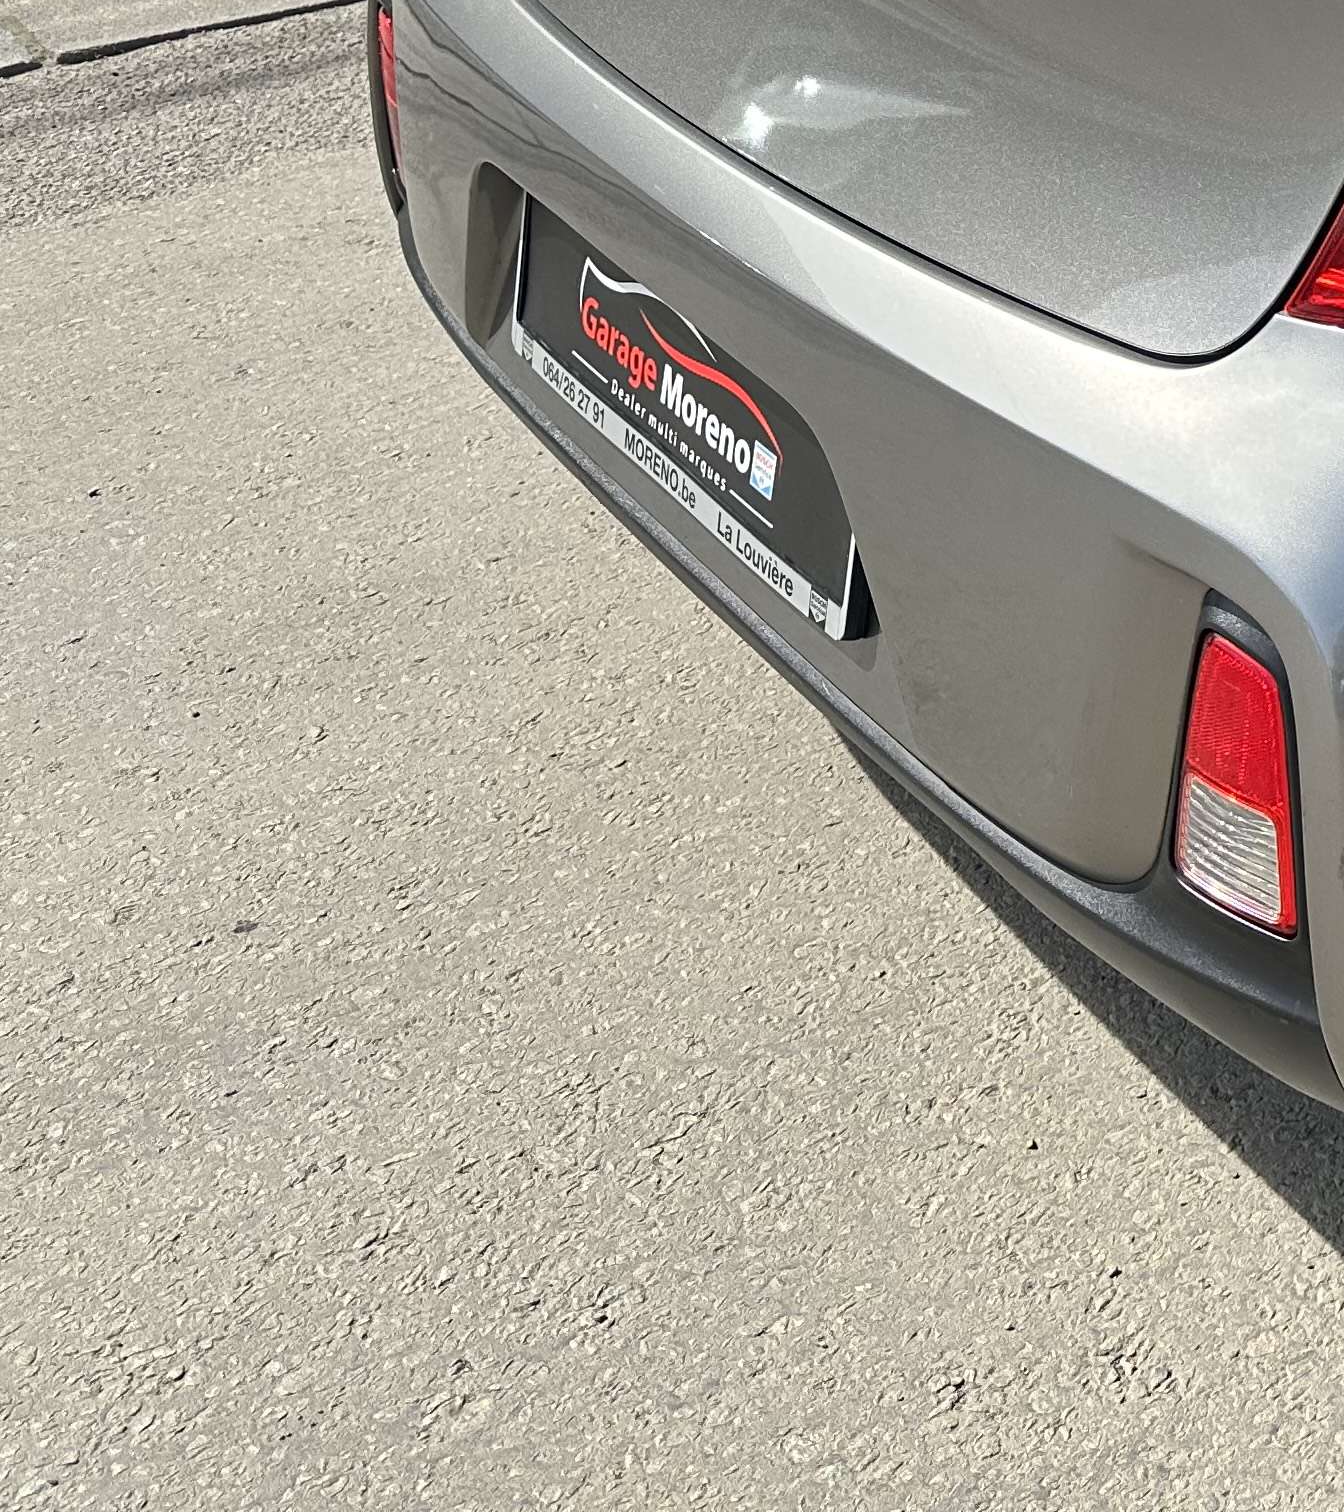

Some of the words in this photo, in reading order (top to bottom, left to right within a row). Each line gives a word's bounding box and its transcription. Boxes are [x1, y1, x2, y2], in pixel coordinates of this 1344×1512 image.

[542, 356, 575, 402] 064/26
[577, 388, 591, 417] 27
[592, 402, 605, 429] 91
[581, 296, 658, 392] Garage
[659, 363, 751, 475] Moreno
[610, 379, 647, 420] Dealer
[648, 413, 678, 447] multi
[679, 440, 727, 492] marques
[624, 428, 697, 509] MORENO.be
[717, 511, 733, 545] La
[735, 529, 794, 596] Louvière
